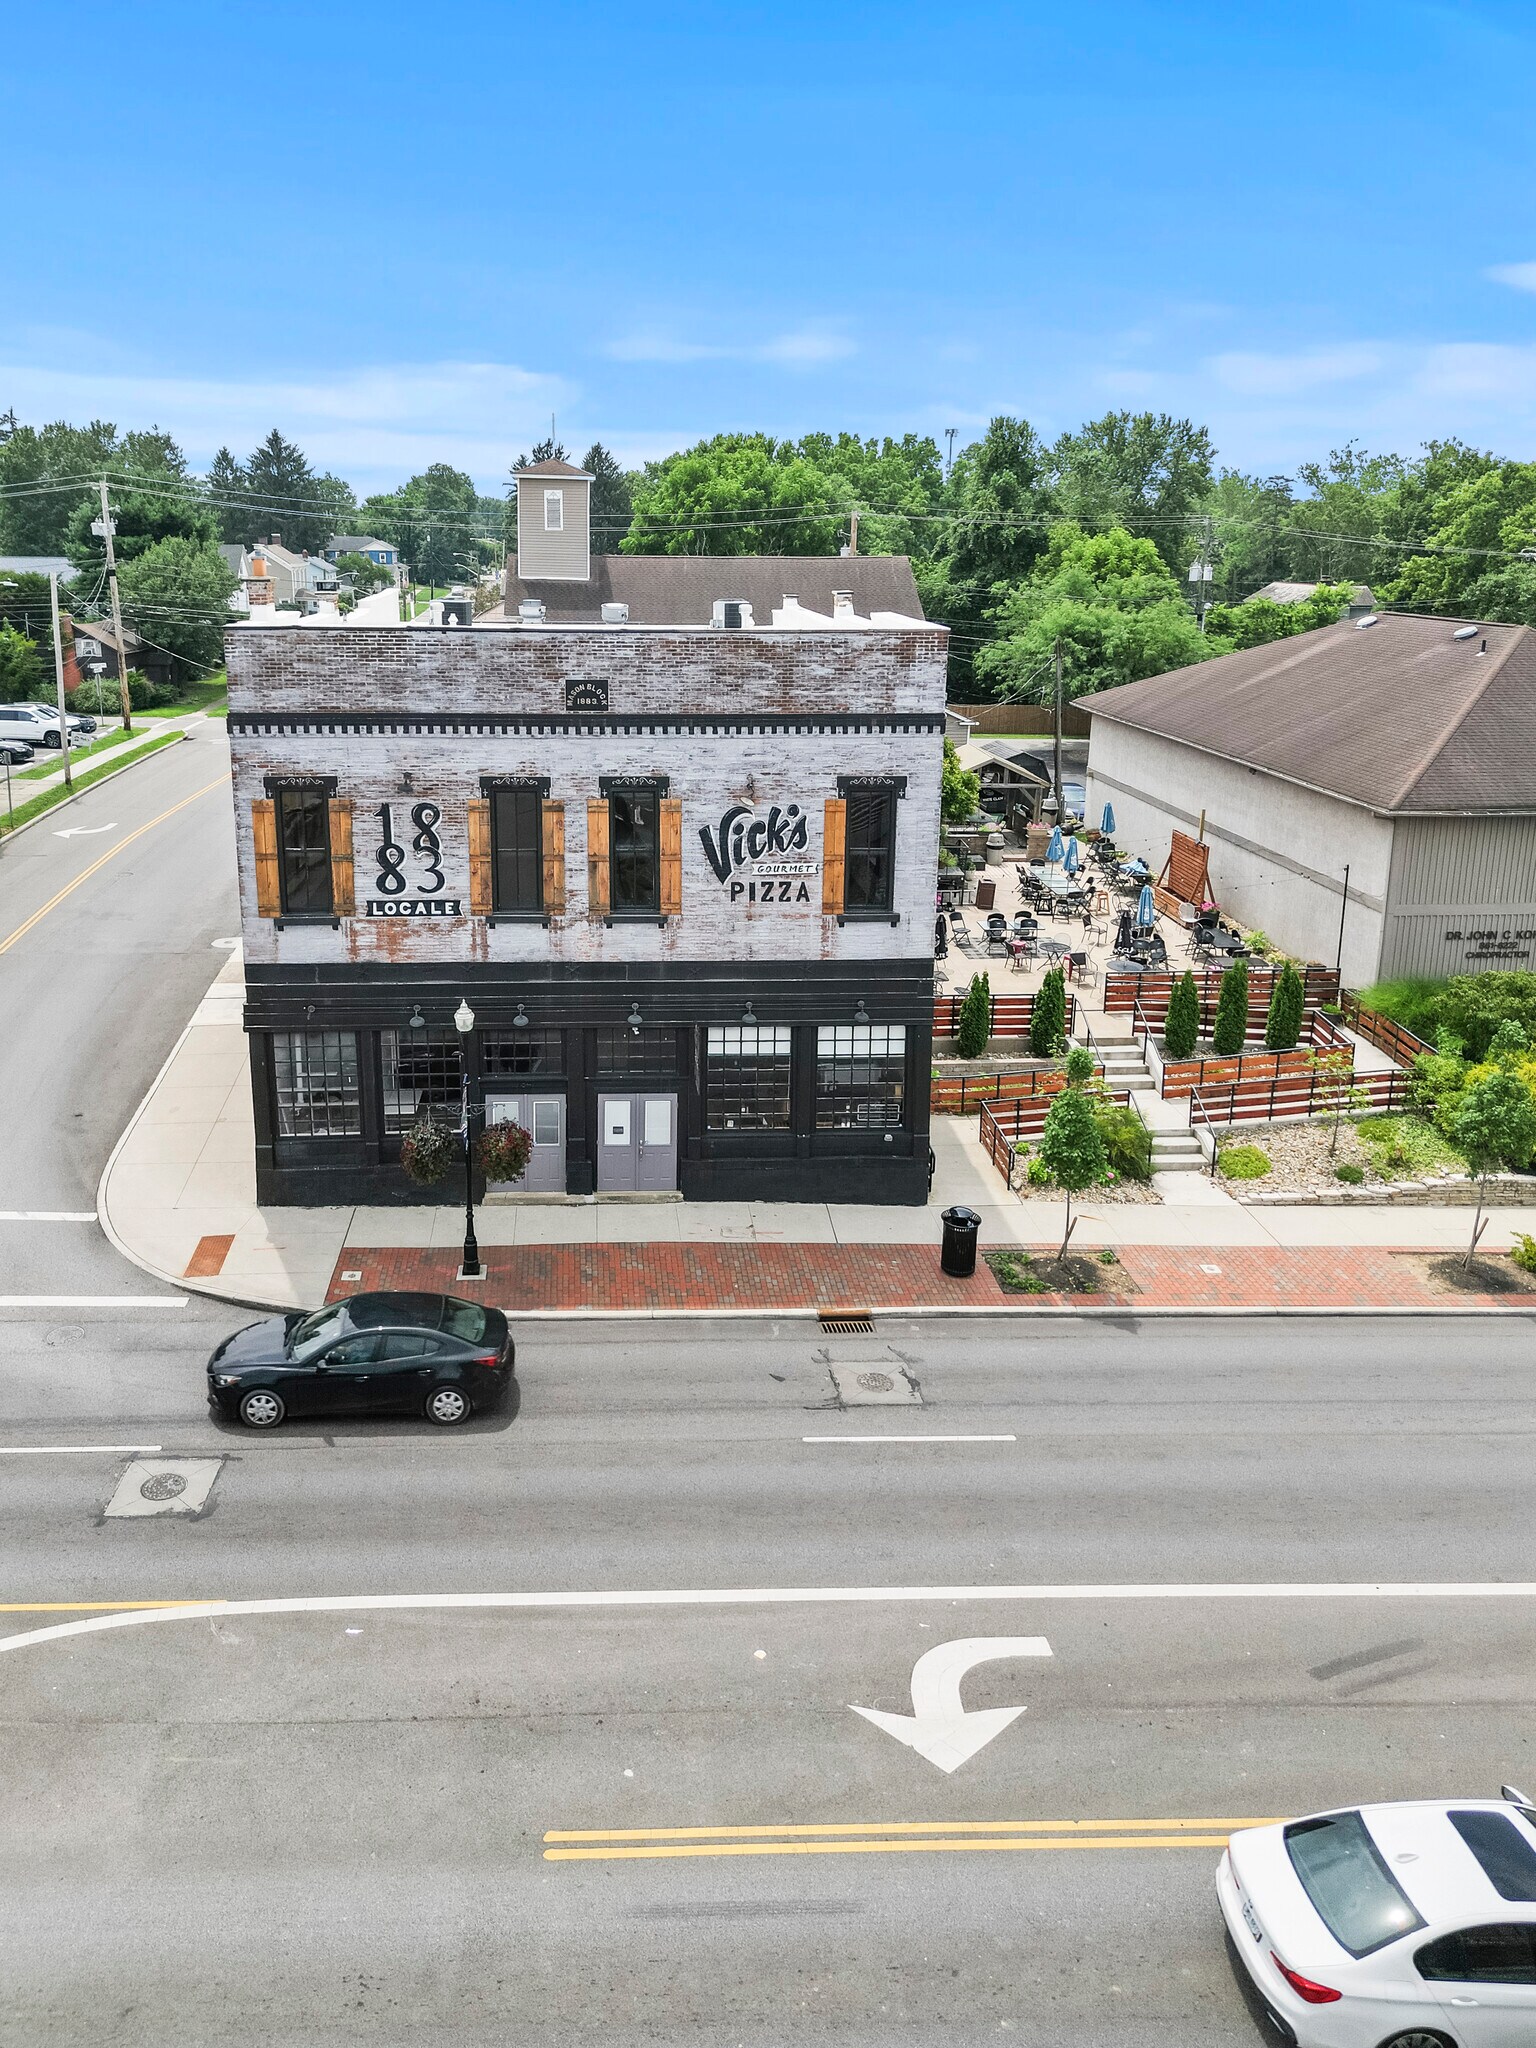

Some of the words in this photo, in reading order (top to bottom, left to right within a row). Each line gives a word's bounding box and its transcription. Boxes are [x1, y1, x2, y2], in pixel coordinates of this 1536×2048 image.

[566, 684, 585, 707] MASON
[586, 683, 608, 706] BLOCK
[698, 804, 808, 885] Vick's
[757, 865, 814, 873] GOURMET
[730, 881, 811, 903] PIZZA
[372, 901, 455, 916] LOCALE
[1466, 930, 1498, 941] JOHN
[1465, 951, 1530, 959] CHIROPRACTOR
